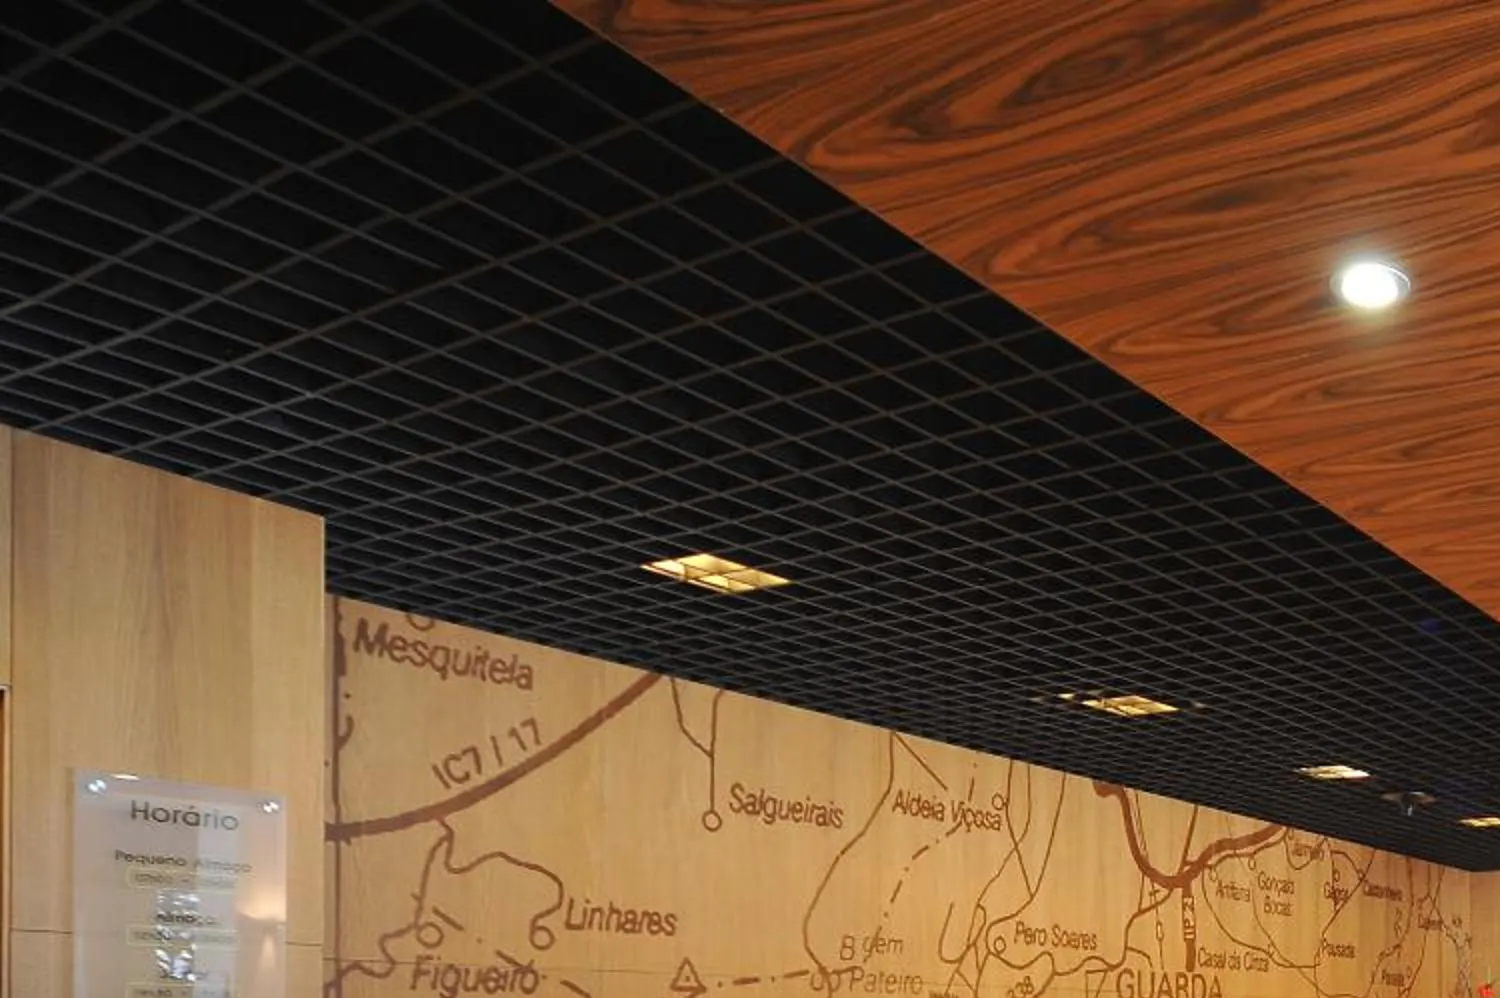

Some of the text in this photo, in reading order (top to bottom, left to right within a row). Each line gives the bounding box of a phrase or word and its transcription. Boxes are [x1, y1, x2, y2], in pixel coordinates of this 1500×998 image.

[353, 617, 533, 690] Mesquitela
[432, 746, 482, 789] IC7
[508, 718, 541, 752] 17
[130, 799, 239, 831] Horário
[729, 783, 844, 829] Salgueirais
[892, 789, 945, 822] Aldeia
[565, 898, 678, 937] Linhares
[1014, 920, 1097, 950] Pero Soares
